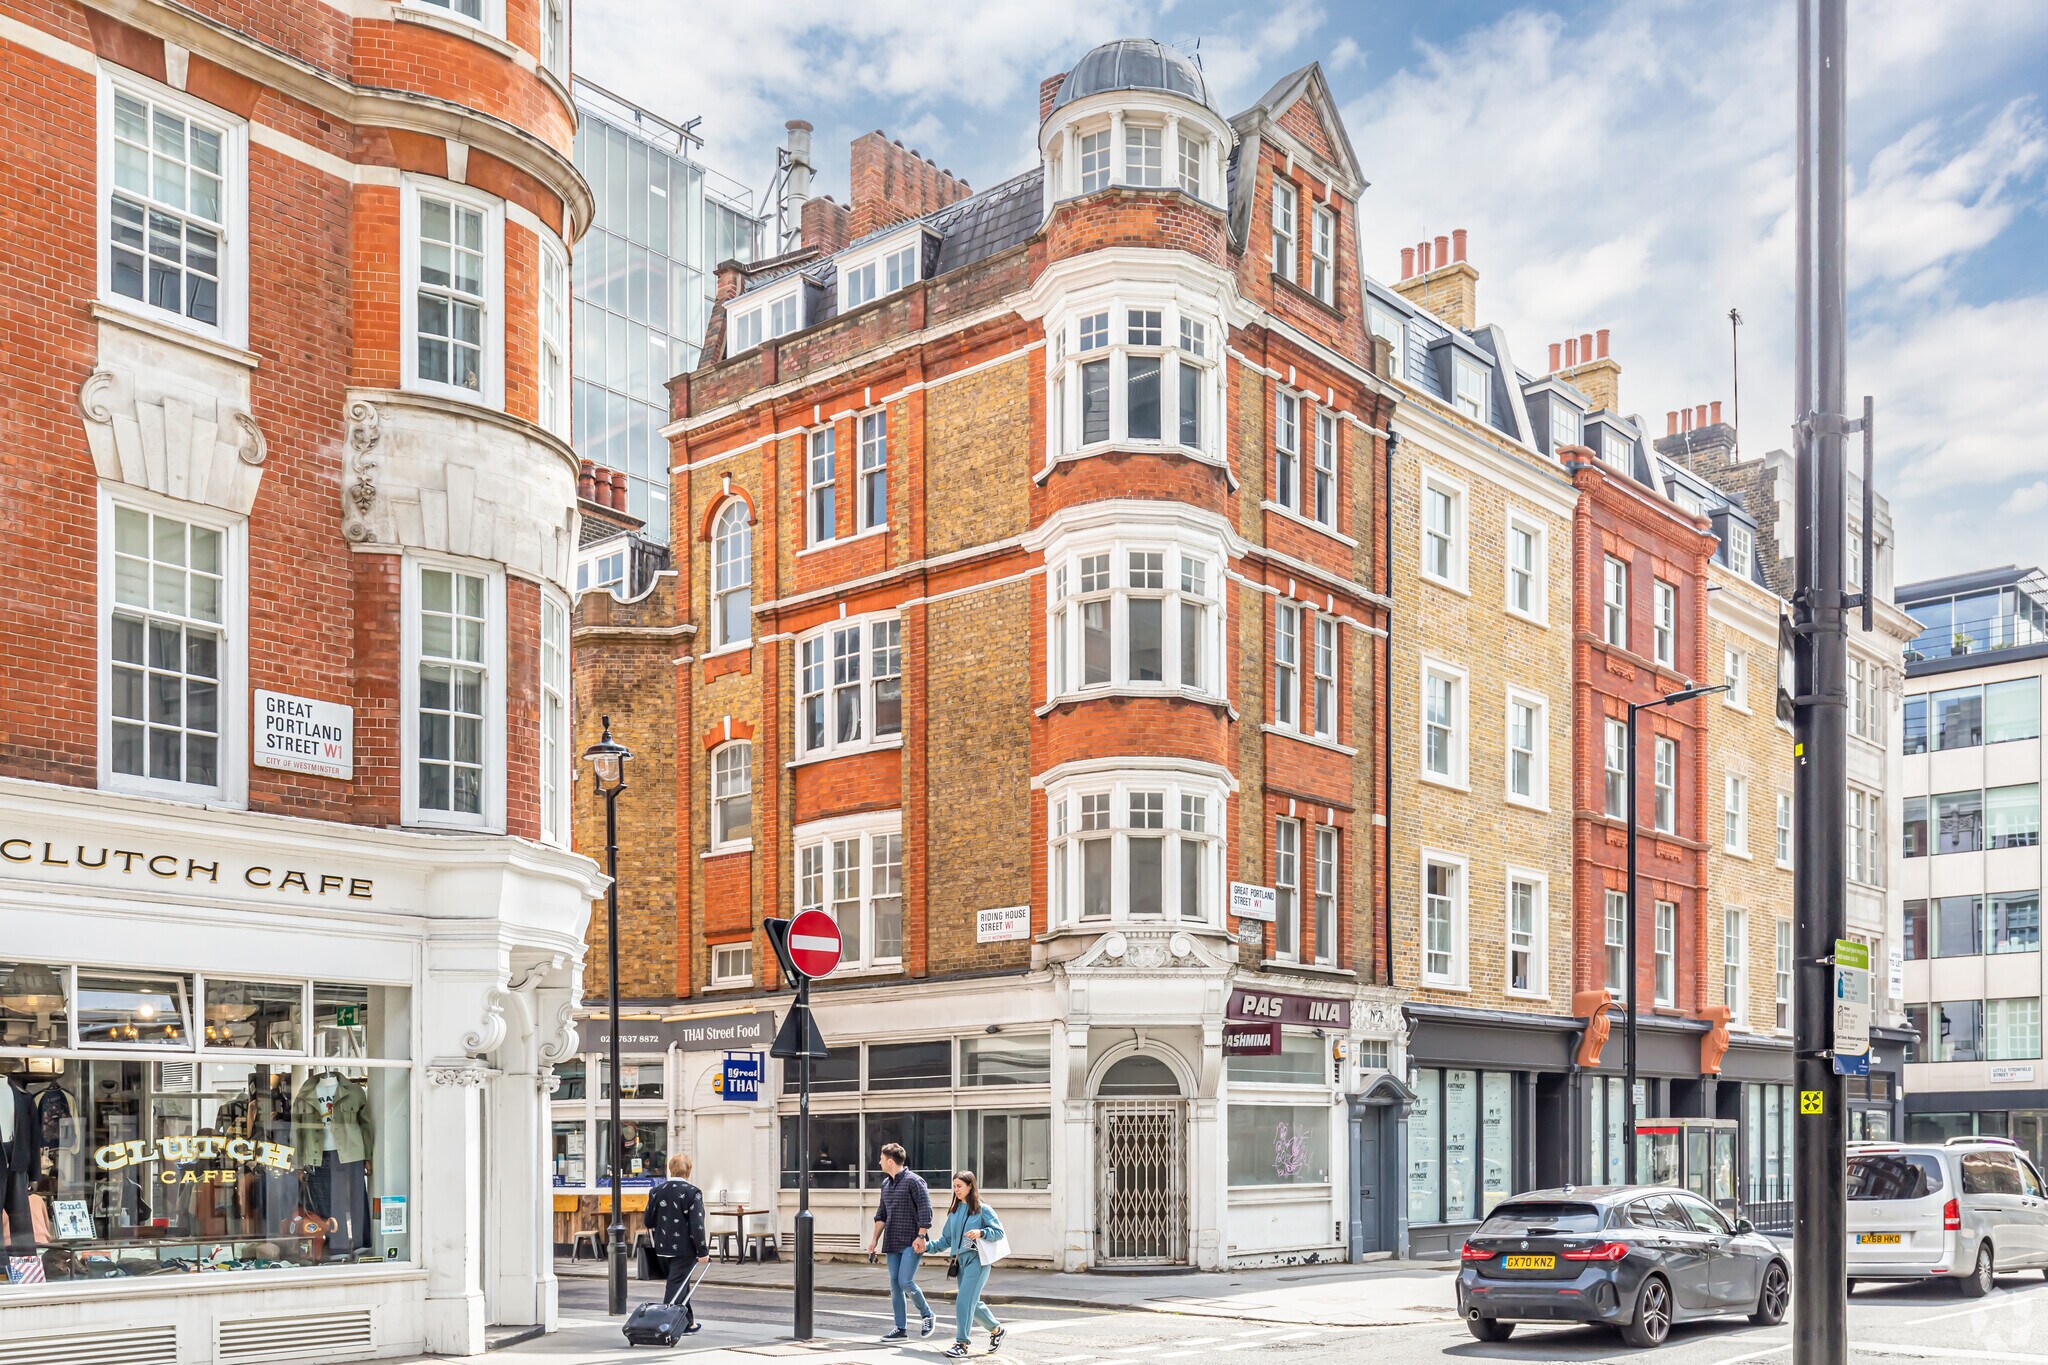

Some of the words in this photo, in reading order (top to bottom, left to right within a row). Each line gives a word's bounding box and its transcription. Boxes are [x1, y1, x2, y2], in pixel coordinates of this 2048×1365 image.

[266, 697, 313, 719] GREAT
[266, 715, 342, 742] PORTLAND
[266, 733, 320, 756] STREET
[323, 742, 343, 760] W1
[266, 756, 280, 766] CITY
[283, 759, 291, 767] OF
[293, 761, 340, 775] WESTMINSTER
[0, 838, 219, 884] CLUTCH
[244, 866, 373, 900] CAFE
[1234, 885, 1249, 896] GREAT
[1251, 888, 1274, 901] PORTLAND
[1234, 895, 1251, 906] STREET
[1254, 899, 1262, 908] W1
[981, 911, 1003, 922] RIDING
[1005, 909, 1026, 920] HOUSE
[980, 921, 1003, 932] STREET
[1005, 921, 1014, 930] W1
[1242, 995, 1284, 1018] PAS
[1308, 1001, 1341, 1022] INA
[619, 1035, 638, 1043] 7637
[639, 1035, 659, 1043] 8872
[683, 1028, 704, 1042] THAI
[706, 1026, 735, 1041] Street
[736, 1023, 760, 1038] Food
[732, 1067, 758, 1079] Great
[728, 1079, 758, 1093] THAI
[93, 1135, 296, 1171] CLUTCH
[160, 1170, 239, 1185] CAFE
[60, 1202, 82, 1210] 2nd
[1861, 1234, 1882, 1243] EX68
[1883, 1234, 1900, 1243] HKO
[1507, 1257, 1532, 1268] GX70
[1533, 1257, 1553, 1268] KNZ
